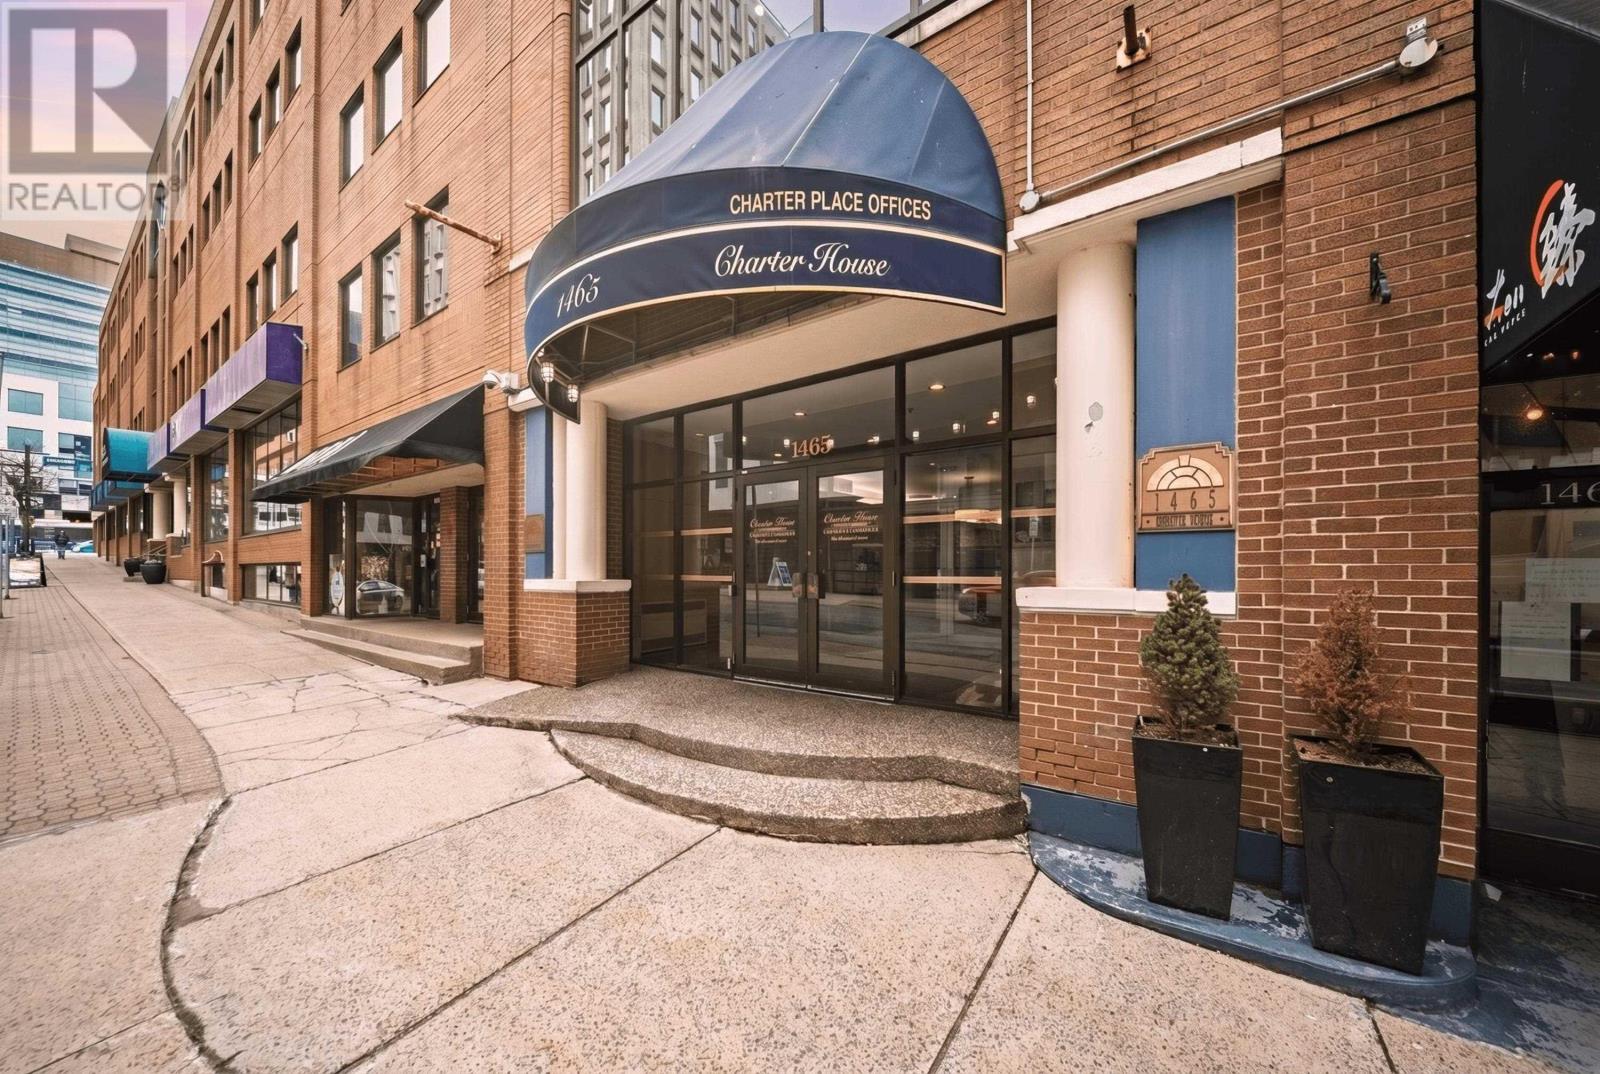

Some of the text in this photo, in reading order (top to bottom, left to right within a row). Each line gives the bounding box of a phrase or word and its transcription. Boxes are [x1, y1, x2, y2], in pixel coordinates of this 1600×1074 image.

[729, 190, 932, 221] CHARTER PLACE OFFICES
[714, 241, 891, 278] Charter House
[556, 273, 601, 319] 1465
[790, 434, 832, 459] 1465
